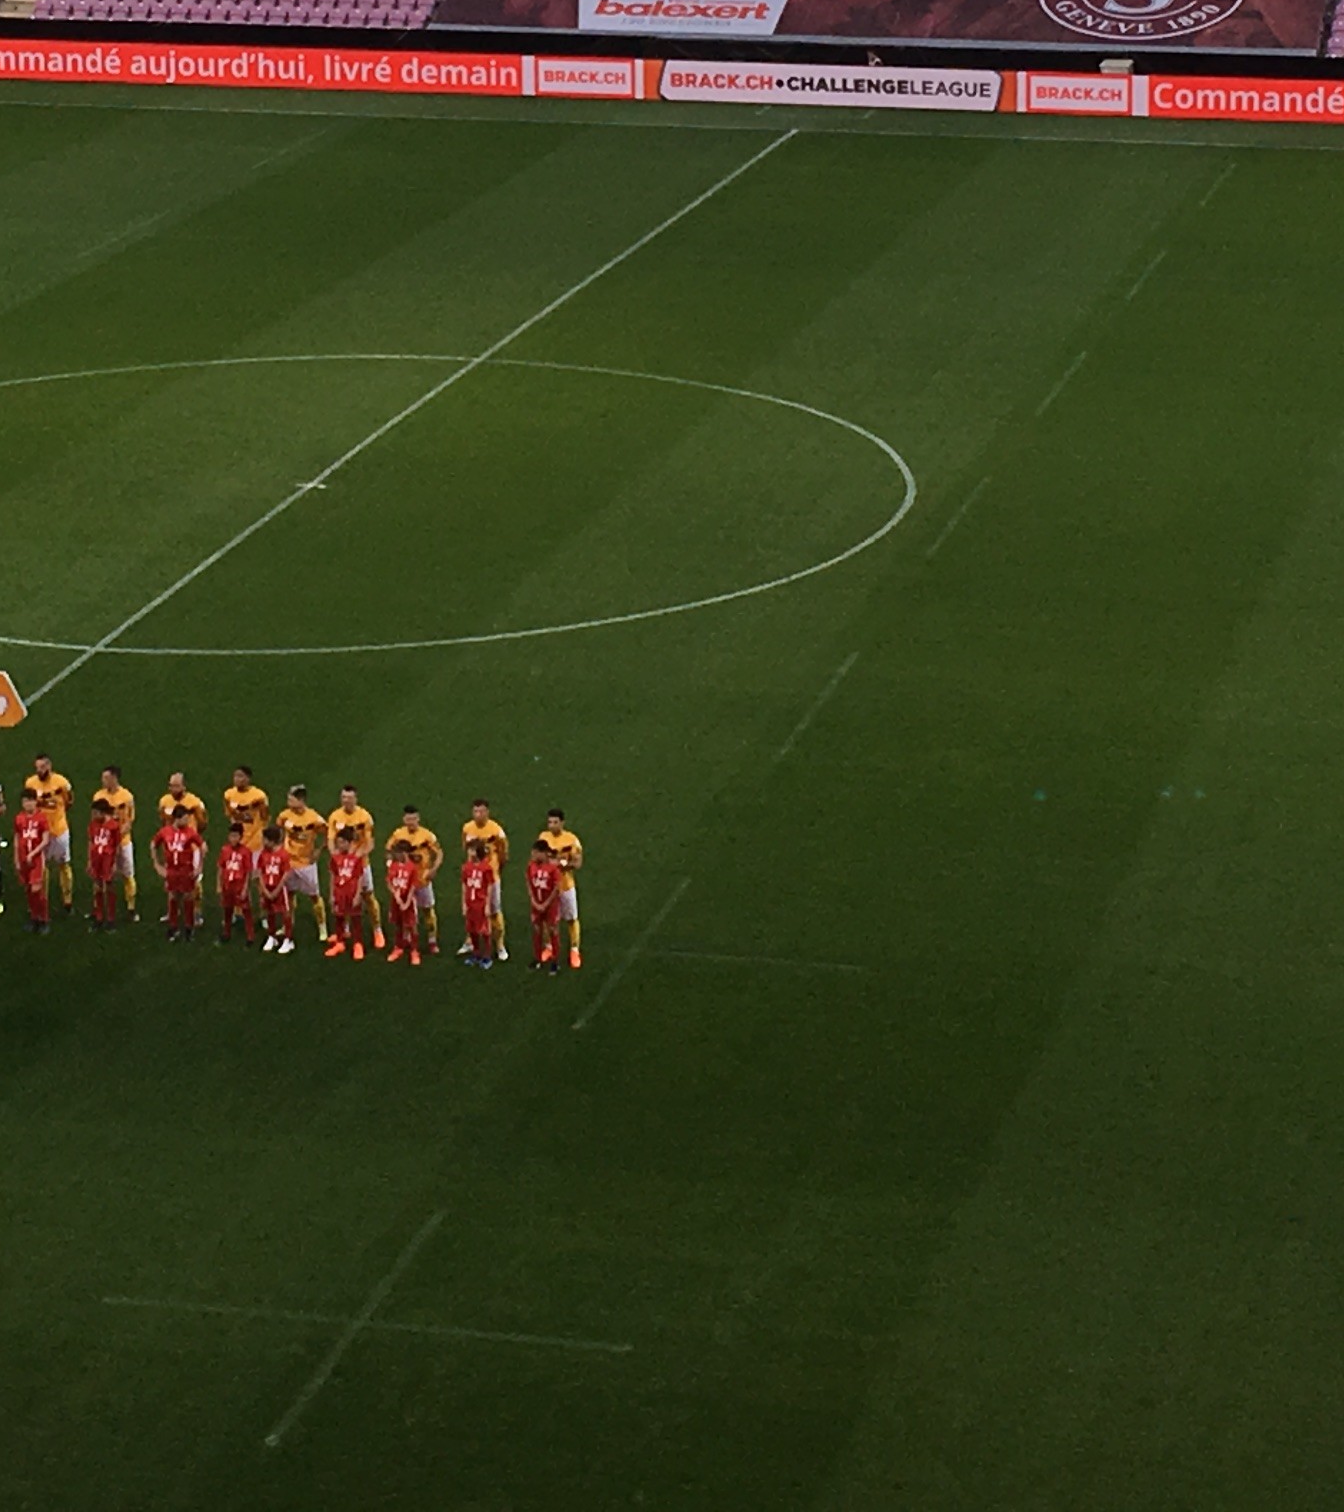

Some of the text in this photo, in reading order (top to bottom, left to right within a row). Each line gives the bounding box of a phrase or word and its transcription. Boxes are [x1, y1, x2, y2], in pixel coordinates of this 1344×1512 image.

[1167, 4, 1221, 31] 1890
[131, 52, 314, 84] aujourd'hui,
[324, 55, 392, 82] livré
[401, 57, 518, 88] demain
[543, 69, 627, 85] BRACK.CH
[1035, 86, 1122, 102] BRACK.CH
[1154, 82, 1344, 115] Commandé
